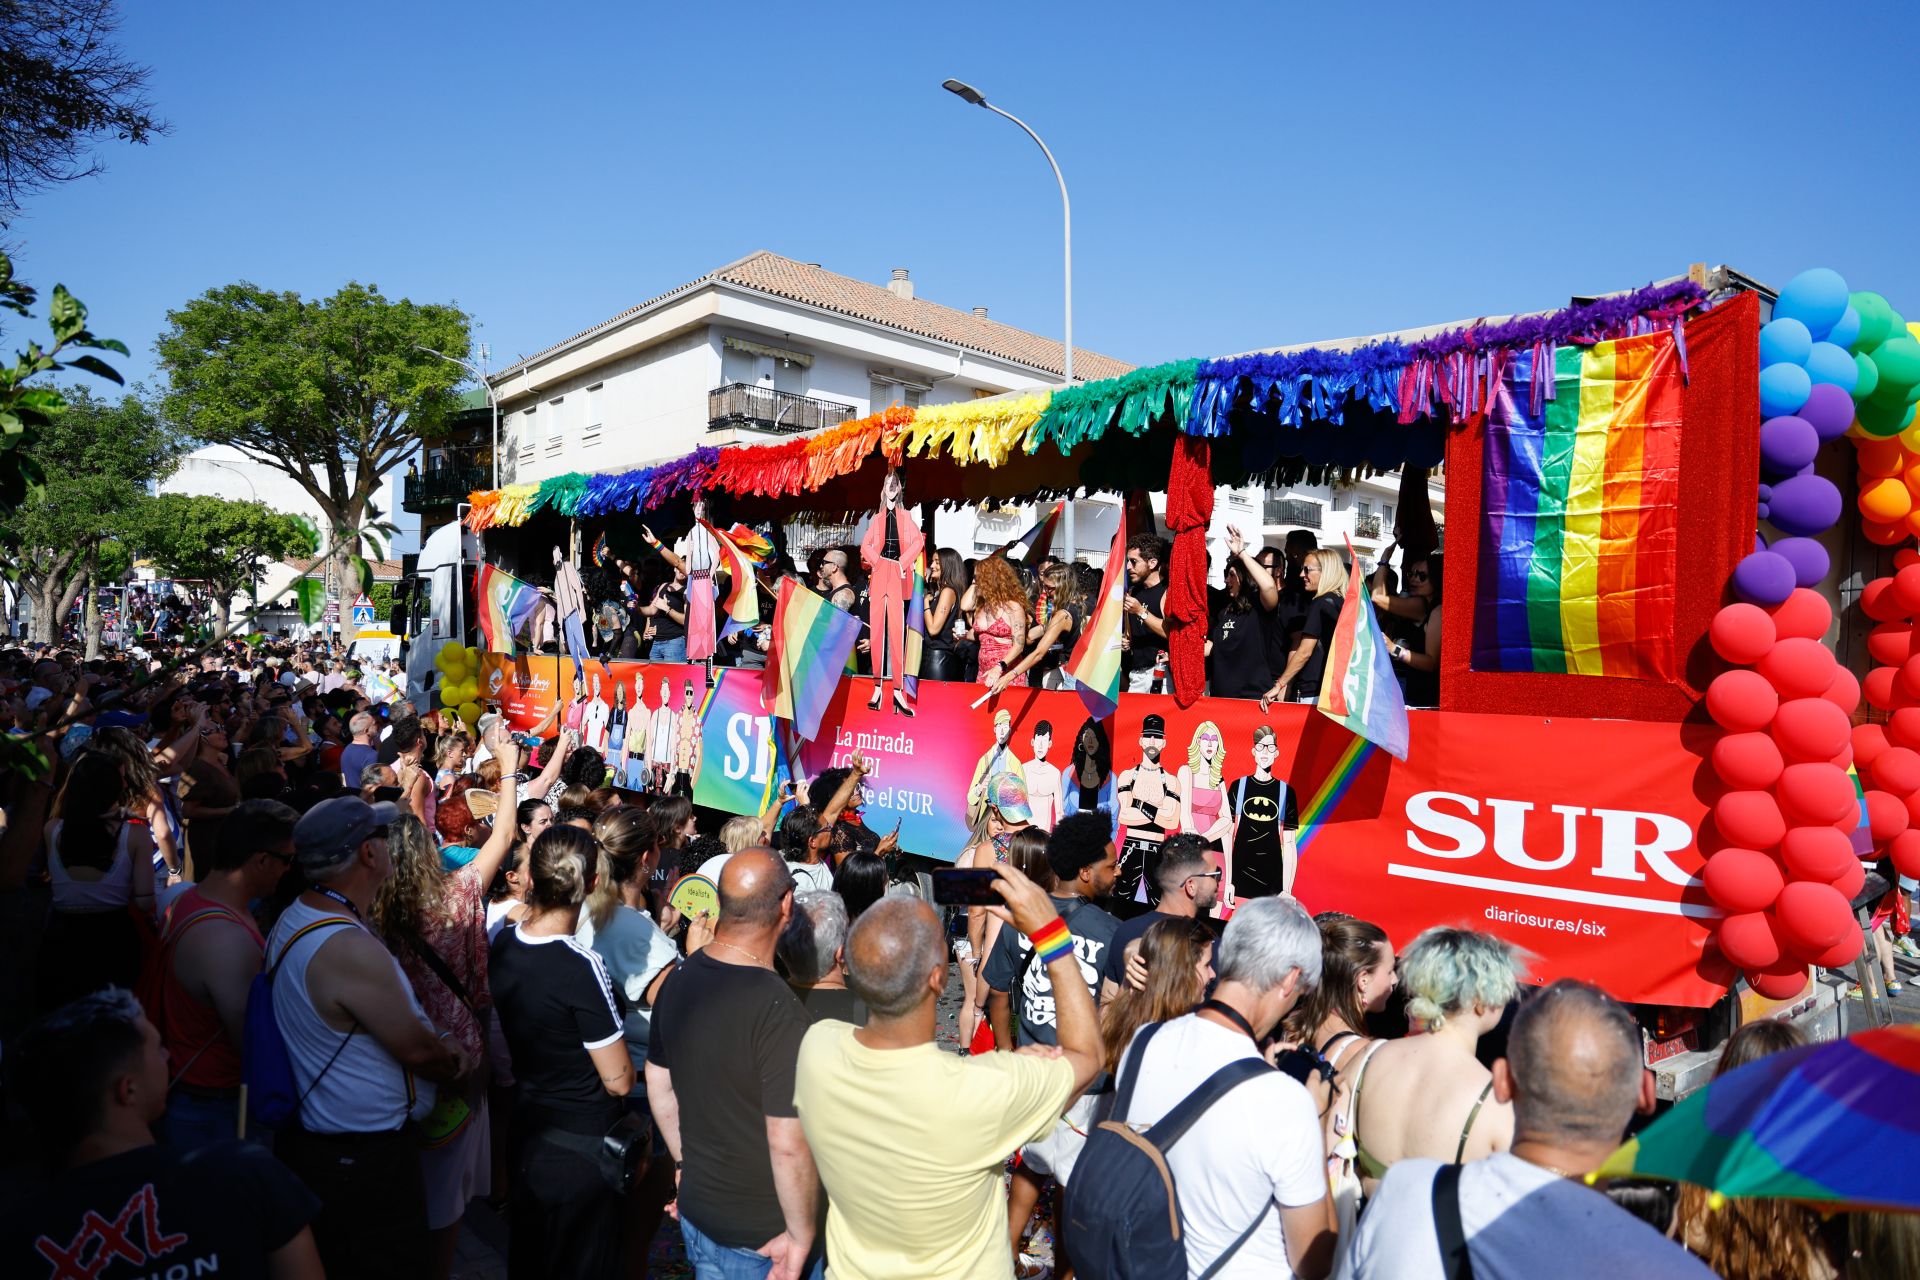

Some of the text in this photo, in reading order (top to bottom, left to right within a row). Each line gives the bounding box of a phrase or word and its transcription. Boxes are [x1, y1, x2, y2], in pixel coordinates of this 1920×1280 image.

[835, 725, 914, 755] La mirada
[832, 752, 882, 778] LGBI
[878, 786, 893, 809] el
[896, 789, 934, 816] SUR
[1405, 790, 1705, 887] SUR
[1484, 905, 1607, 937] diariosur.es/six
[35, 1182, 188, 1280] XXL
